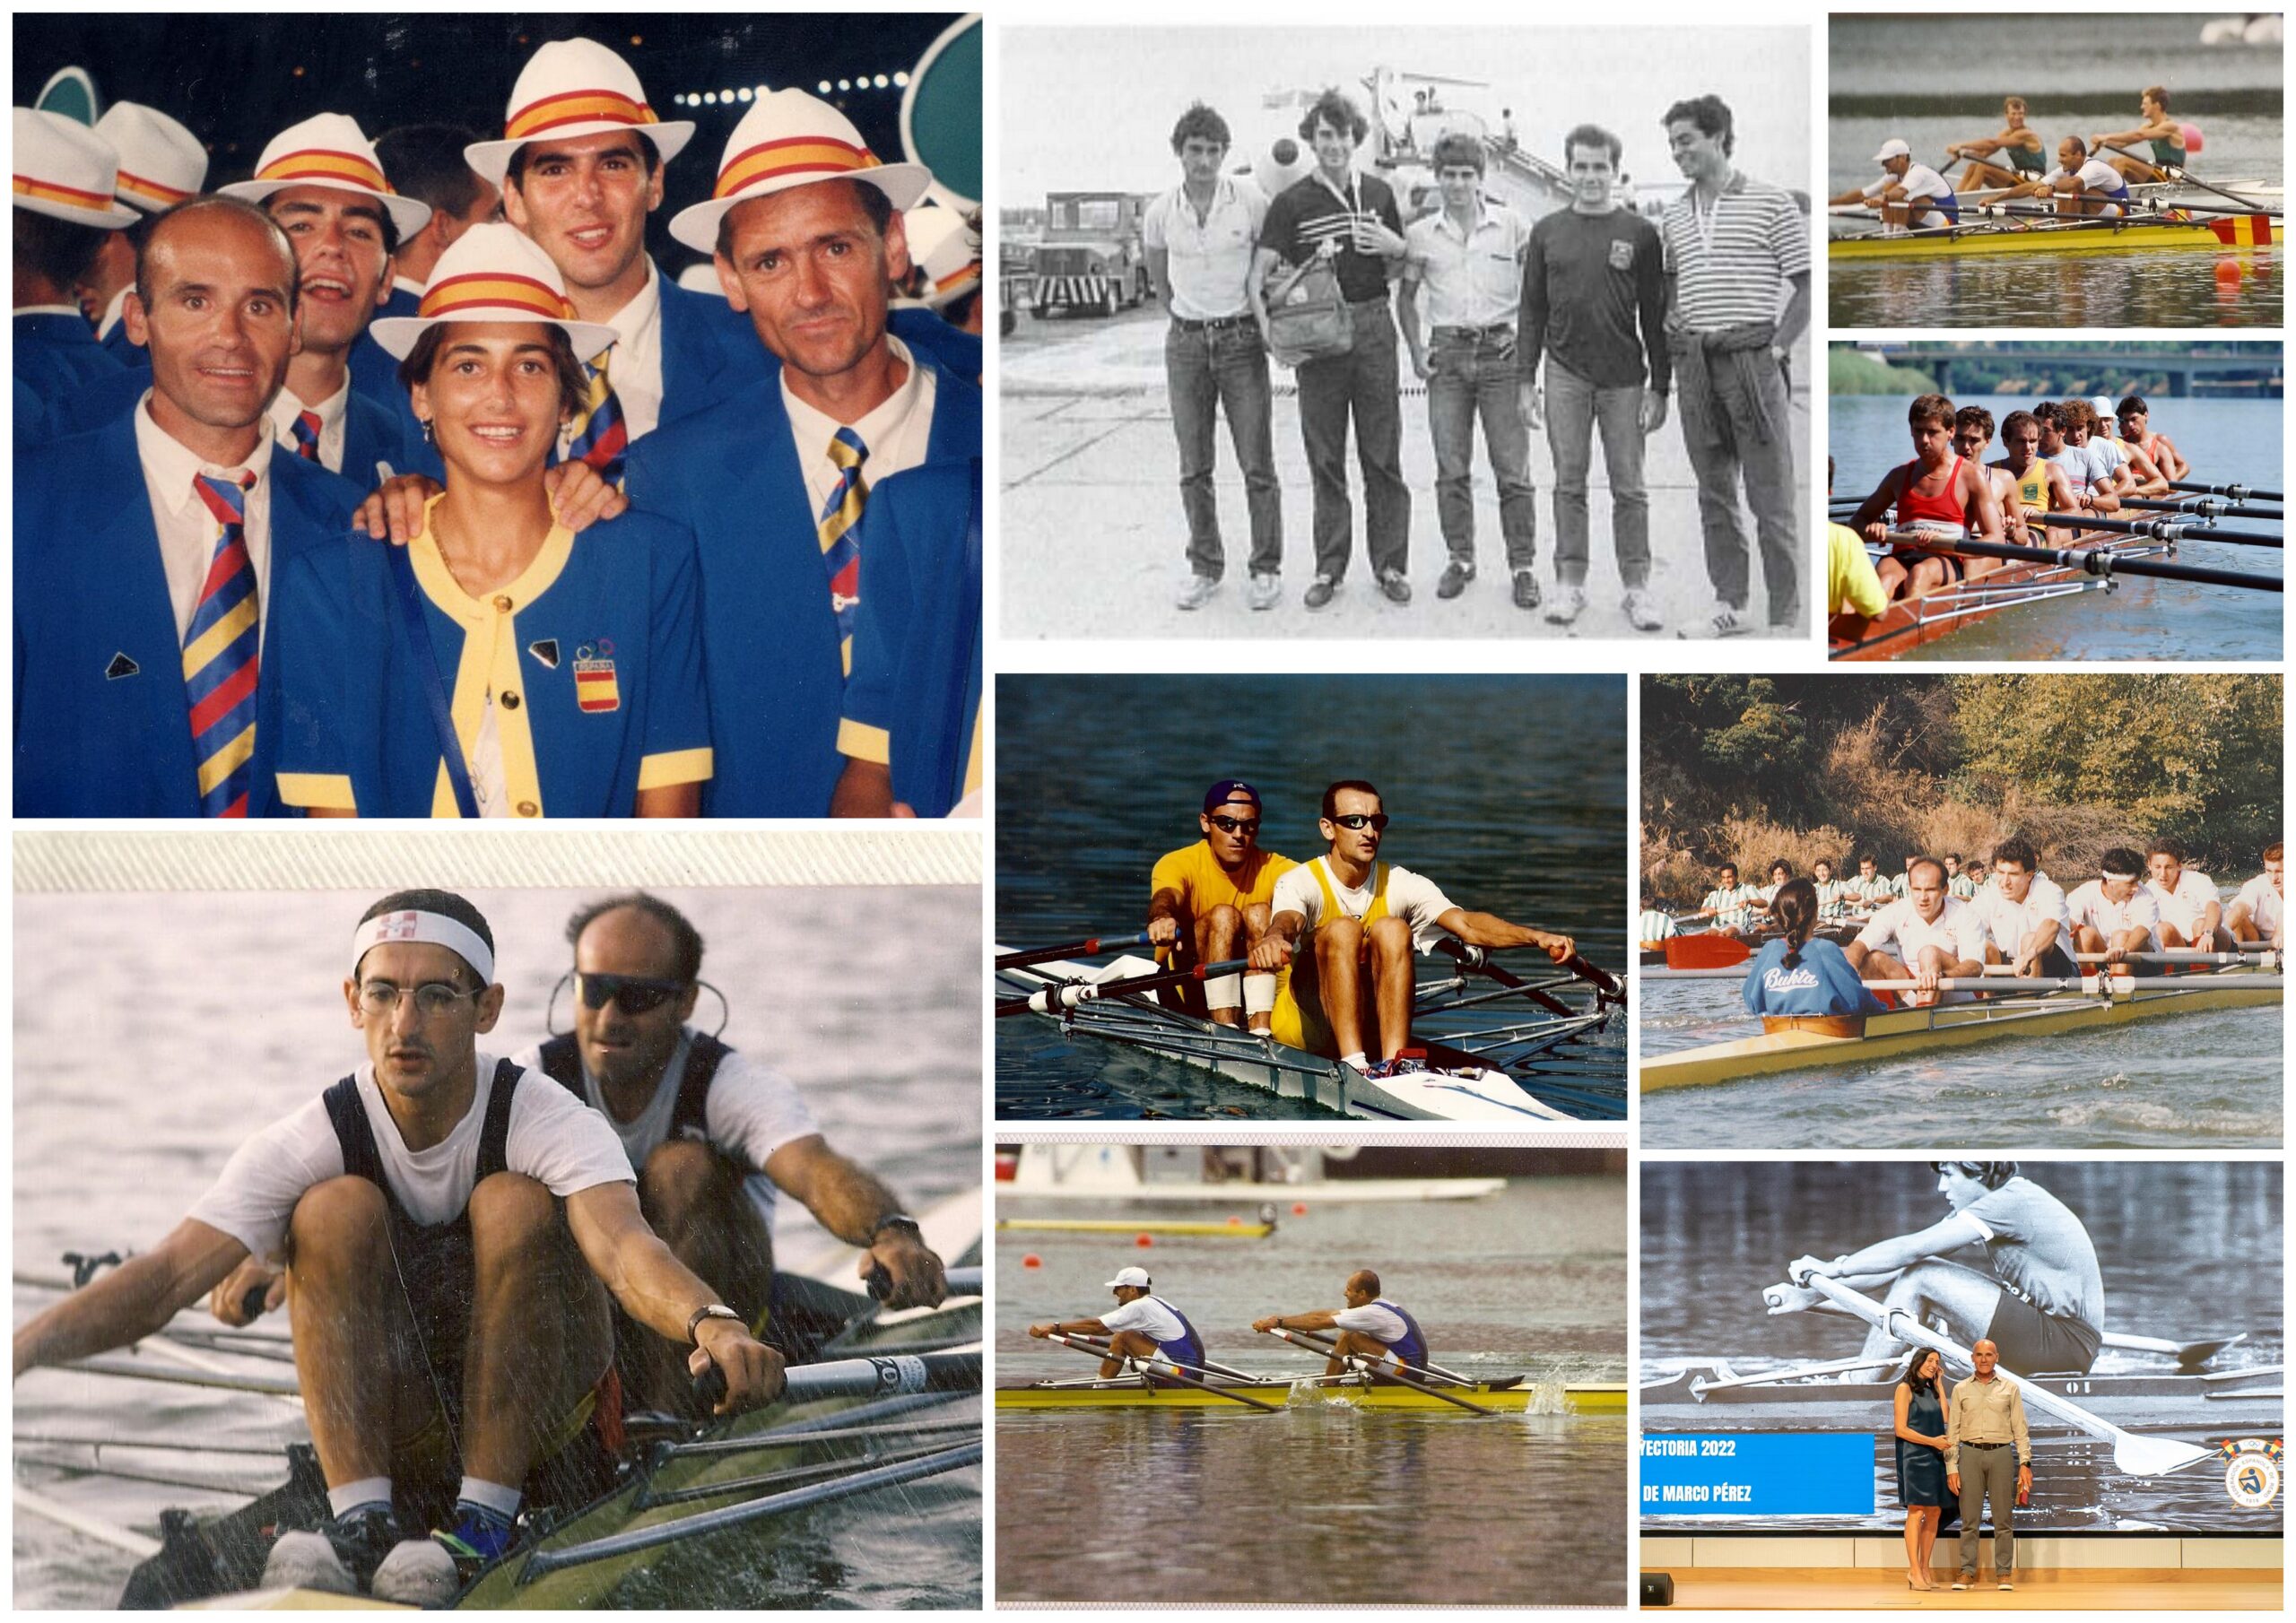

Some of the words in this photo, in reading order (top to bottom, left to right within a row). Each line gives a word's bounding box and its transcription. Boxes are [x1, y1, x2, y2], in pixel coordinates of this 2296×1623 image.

[1700, 1439, 1736, 1457] 2022
[1643, 1485, 1659, 1502] DE
[1663, 1485, 1709, 1502] MARCO
[1712, 1481, 1752, 1502] PÉREZ
